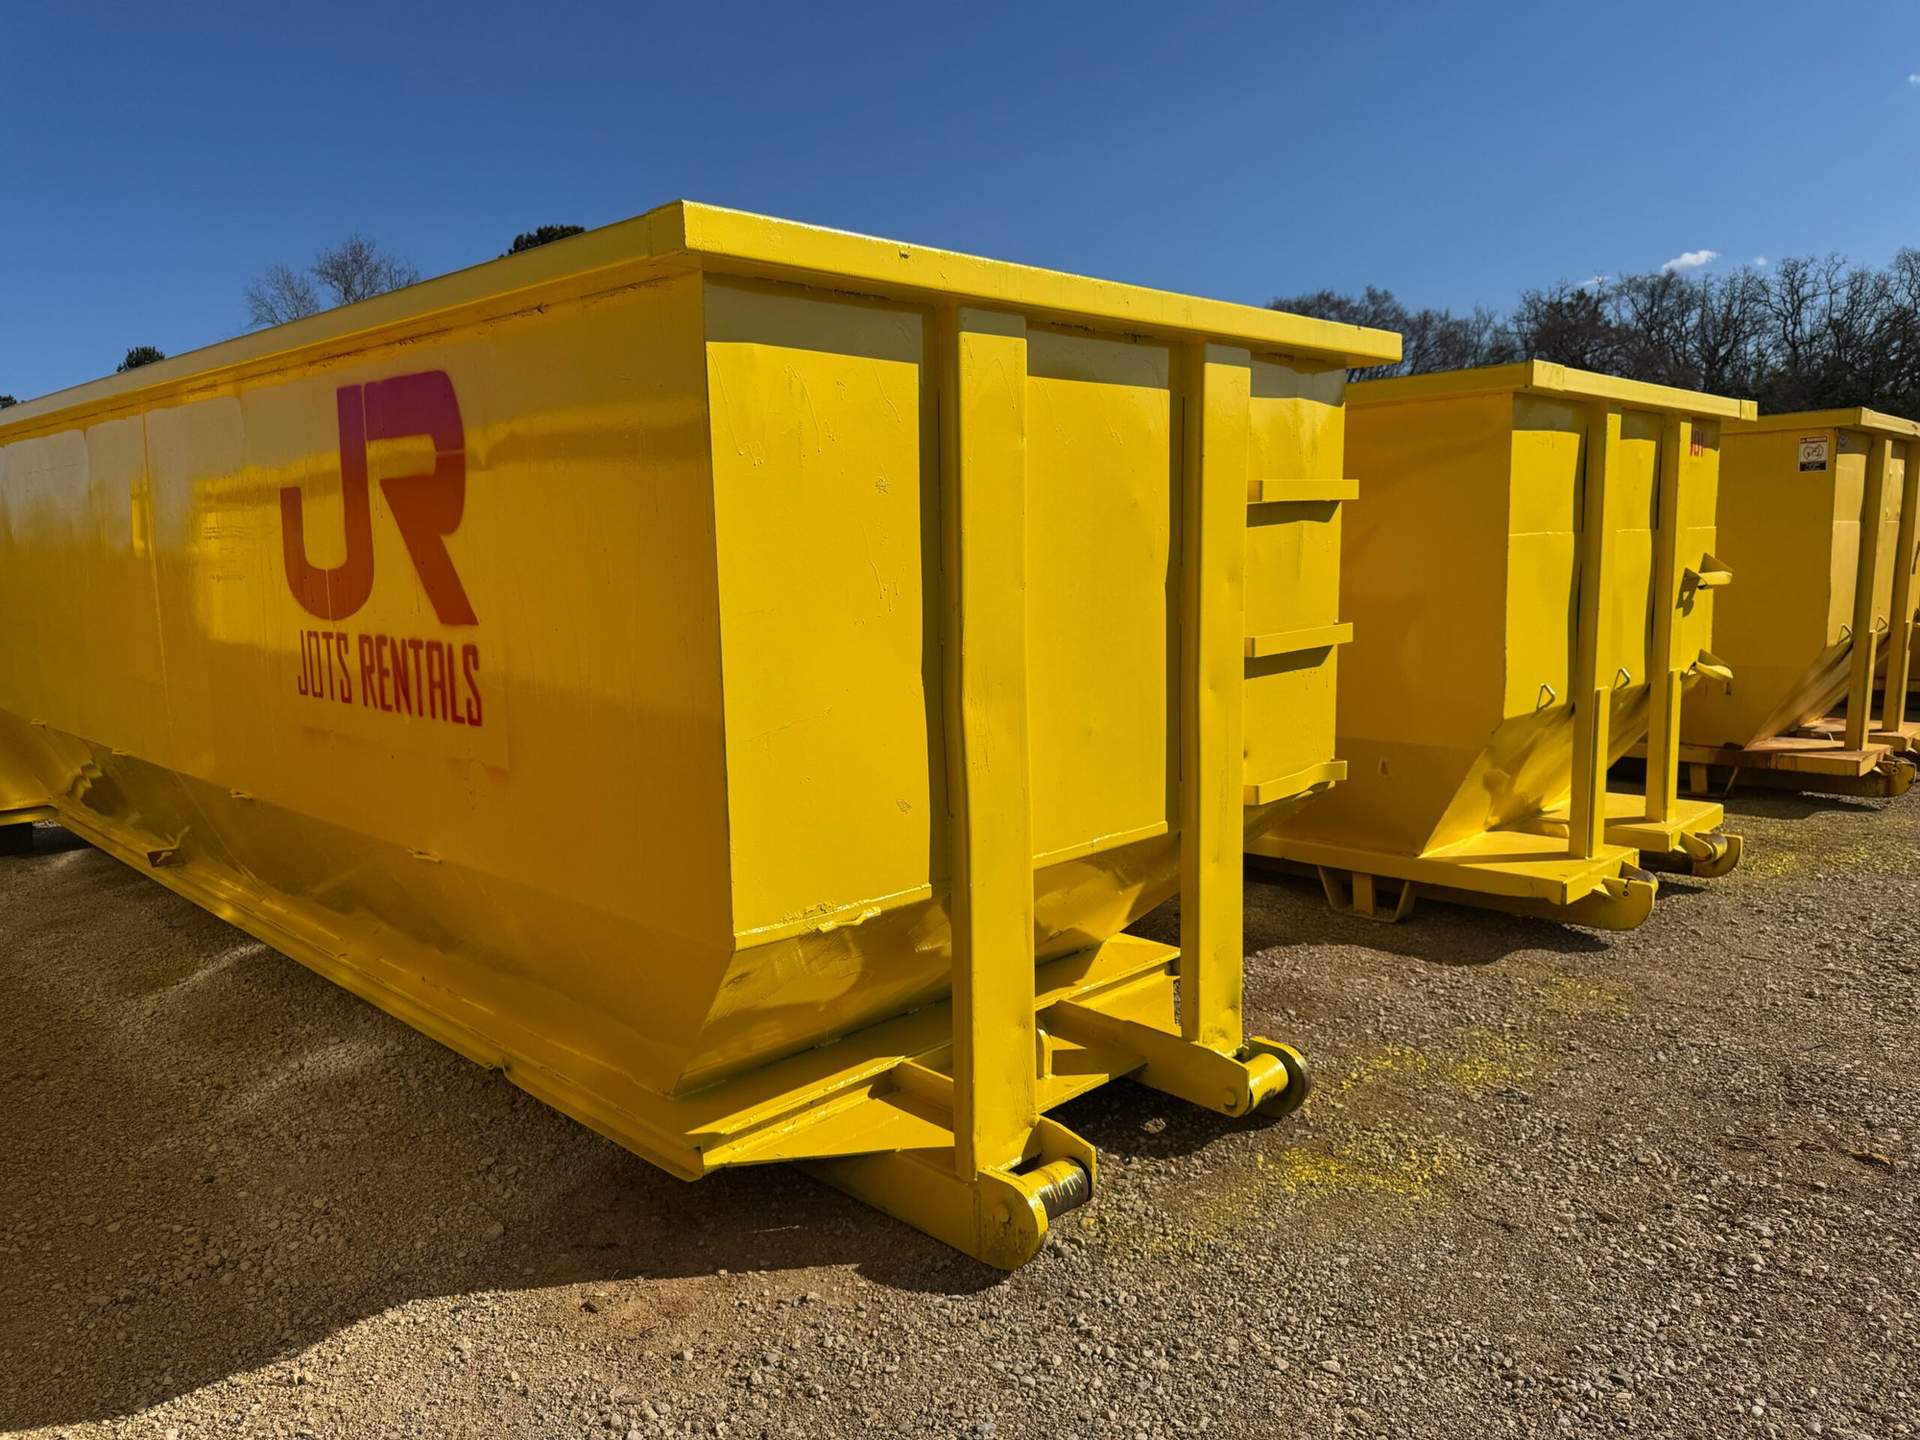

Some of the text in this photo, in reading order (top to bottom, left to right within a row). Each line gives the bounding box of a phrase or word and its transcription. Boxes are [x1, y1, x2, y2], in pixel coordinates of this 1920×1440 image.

[279, 370, 479, 627] JR
[298, 629, 483, 727] JOTS RENTALS
